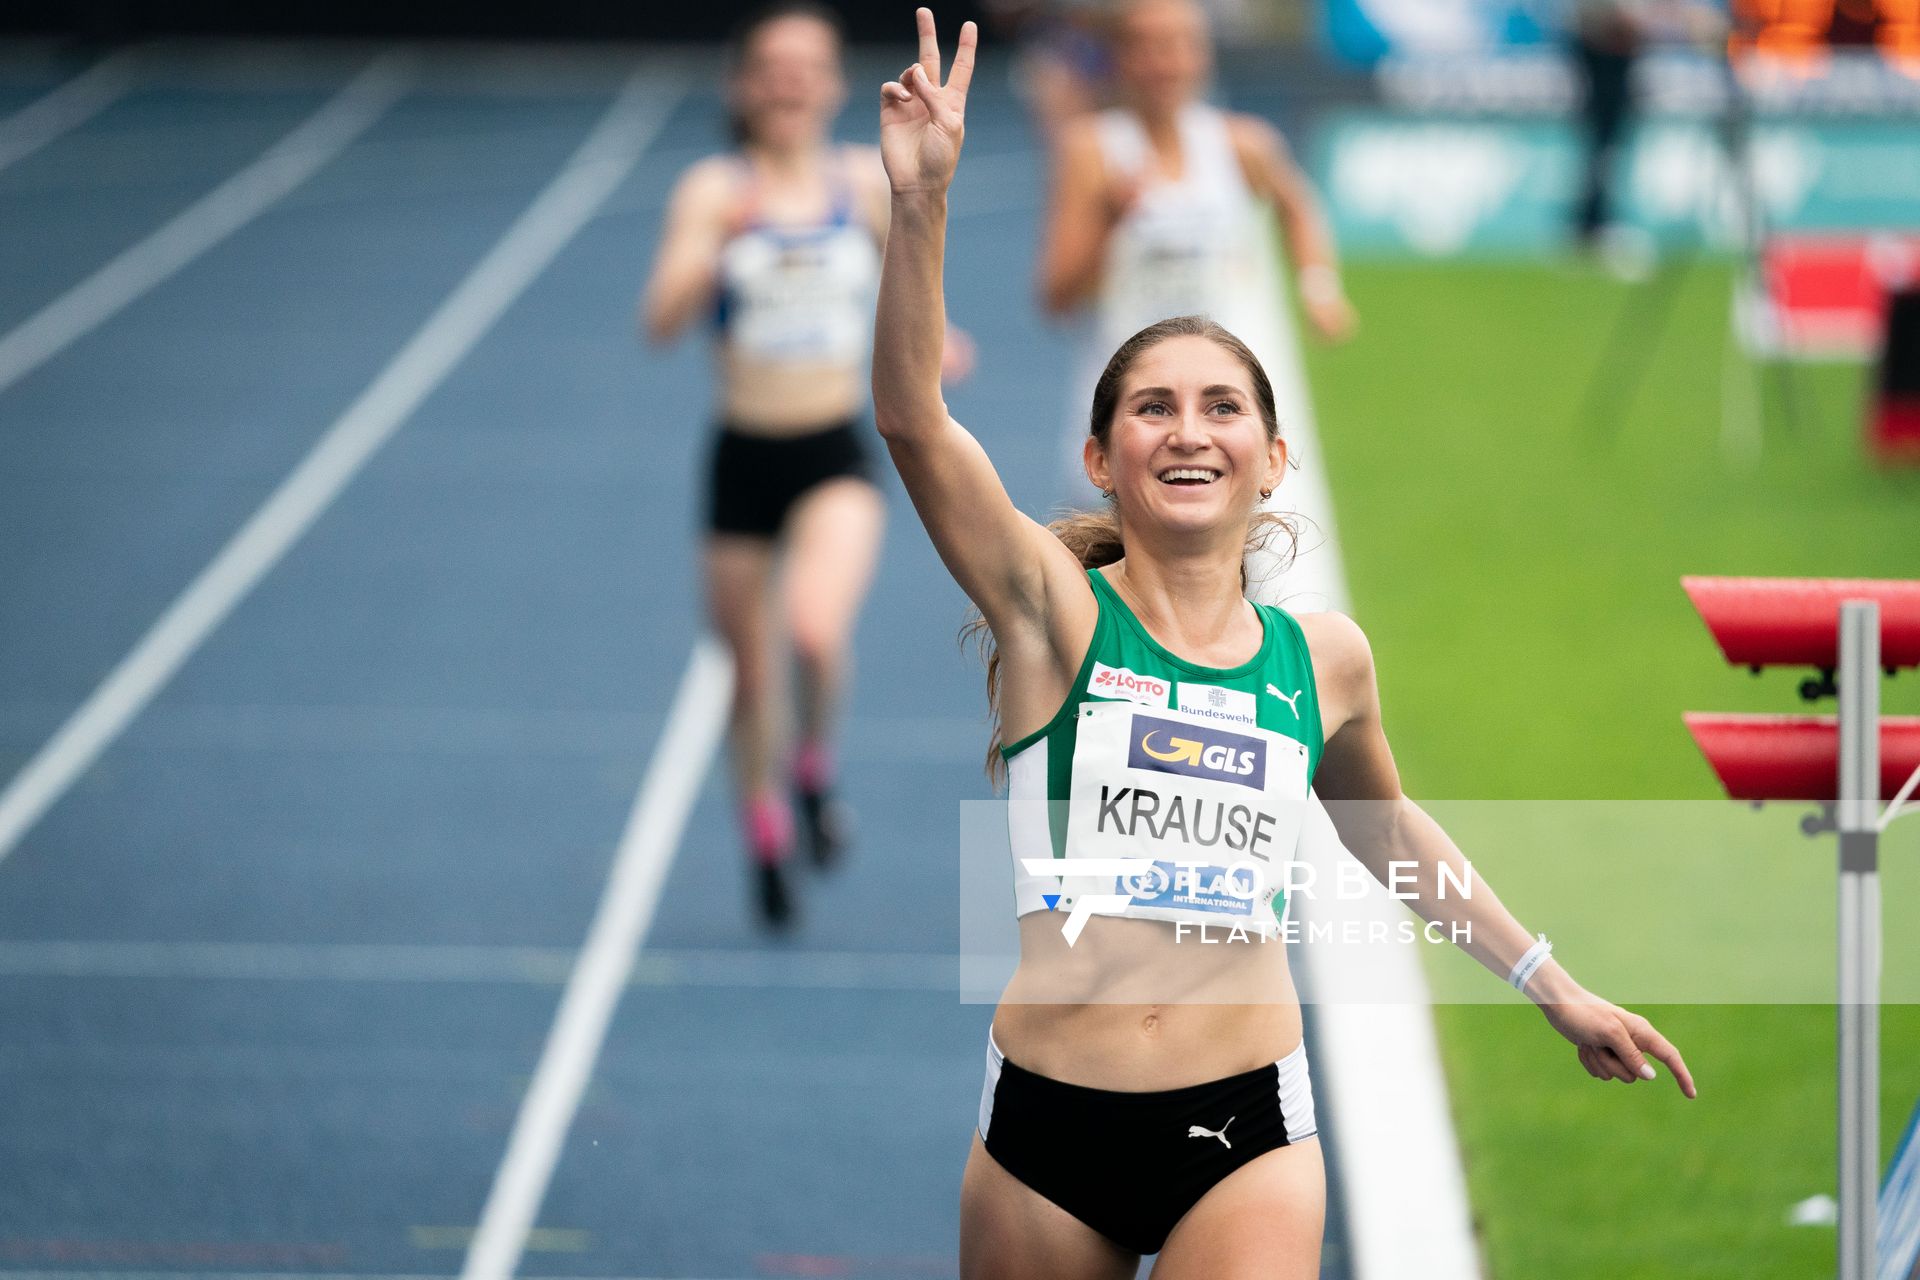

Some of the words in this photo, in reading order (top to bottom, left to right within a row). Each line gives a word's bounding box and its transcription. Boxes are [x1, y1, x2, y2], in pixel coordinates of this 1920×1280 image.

[1117, 673, 1164, 696] LOTTO
[1181, 704, 1254, 725] Bundeswehr
[1202, 745, 1256, 776] GLS
[1097, 785, 1277, 862] KRAUSE
[1174, 870, 1250, 898] PLAN
[1173, 894, 1248, 910] INTERNATIONAL
